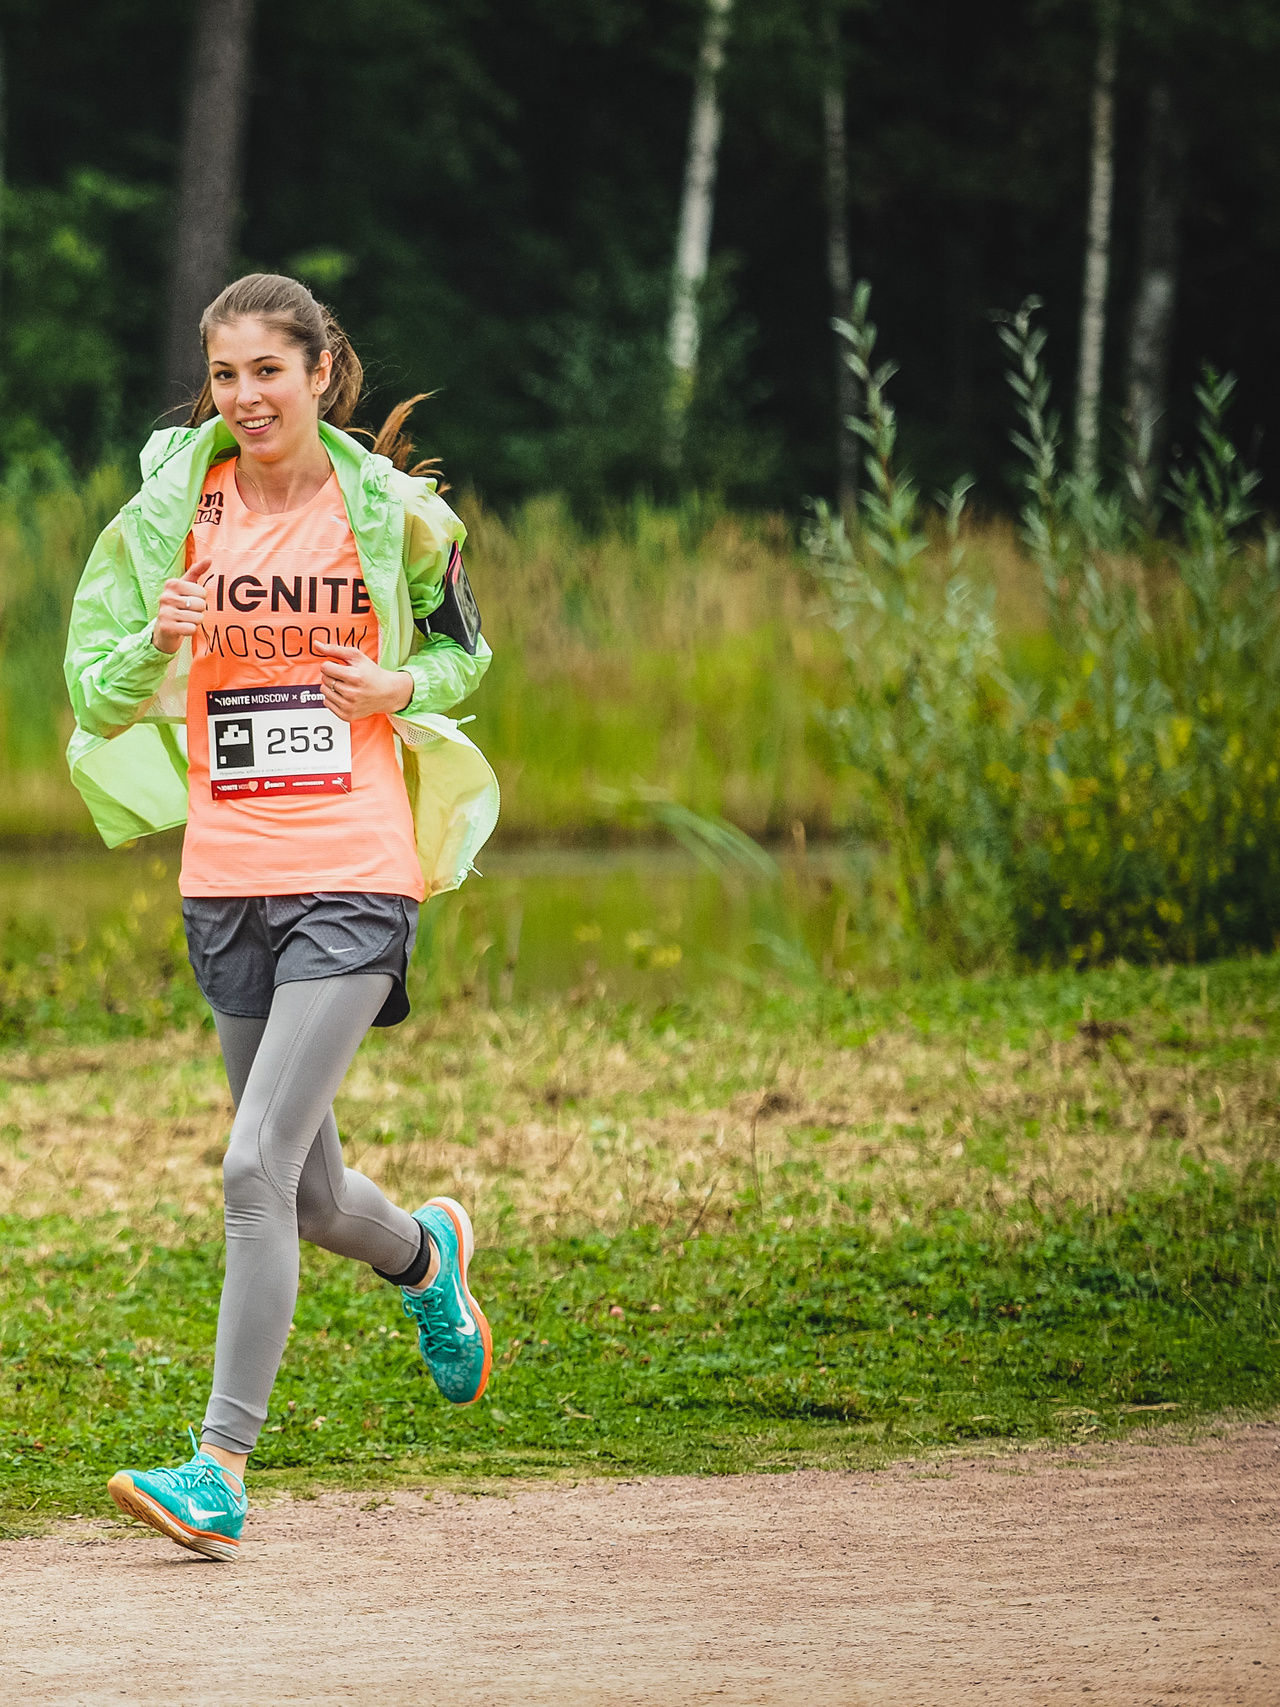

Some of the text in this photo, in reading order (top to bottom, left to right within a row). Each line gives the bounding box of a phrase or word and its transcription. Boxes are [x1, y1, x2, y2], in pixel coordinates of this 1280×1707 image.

[216, 575, 371, 614] IGNITE
[201, 624, 368, 659] MOSCOW
[222, 695, 251, 707] IGNITE
[251, 693, 290, 704] MOSCOW
[266, 725, 334, 755] 253
